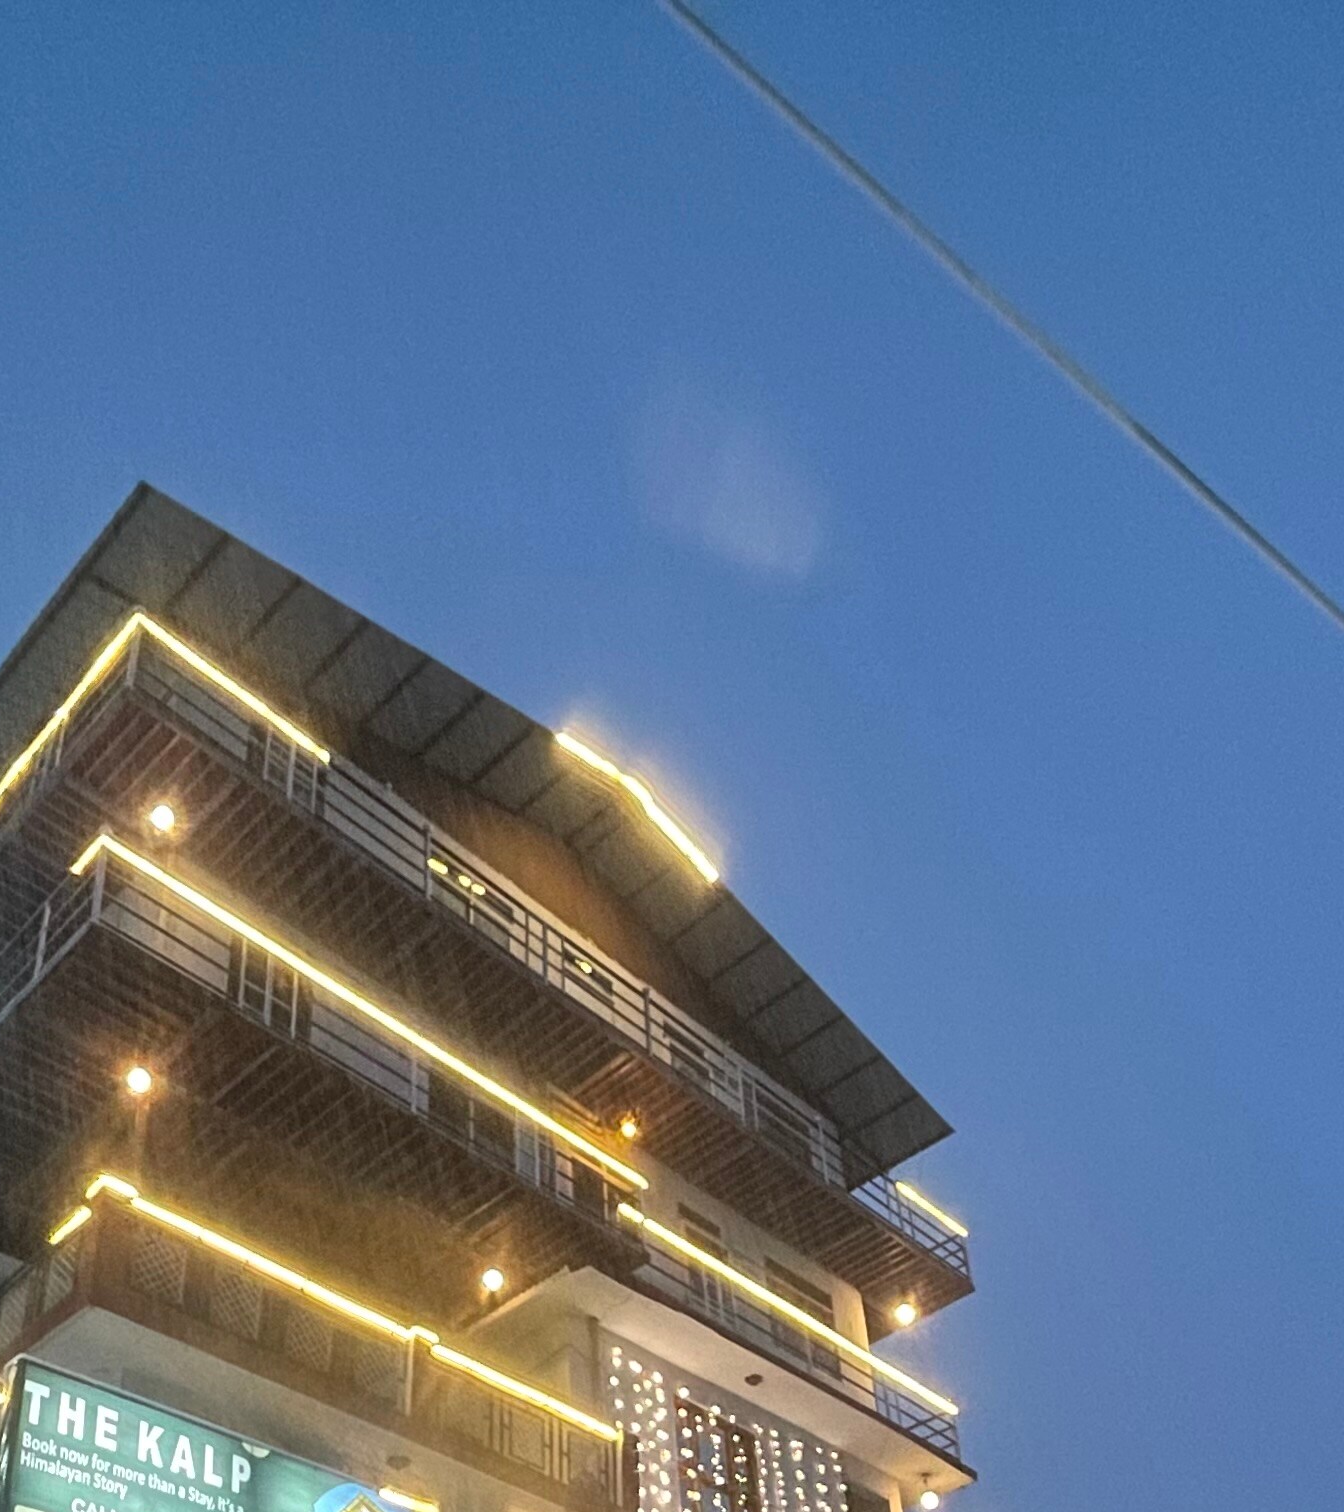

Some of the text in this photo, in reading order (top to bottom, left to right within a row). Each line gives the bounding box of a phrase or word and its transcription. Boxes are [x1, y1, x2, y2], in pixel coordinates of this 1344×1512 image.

[20, 1448, 129, 1501] Himalayan Story
[21, 1431, 58, 1457] Book
[59, 1446, 90, 1467] now
[91, 1452, 111, 1473] for
[112, 1463, 146, 1486] more
[148, 1472, 176, 1496] than
[177, 1485, 186, 1499] a
[187, 1485, 216, 1511] Stay,
[23, 1379, 252, 1494] THE KALP
